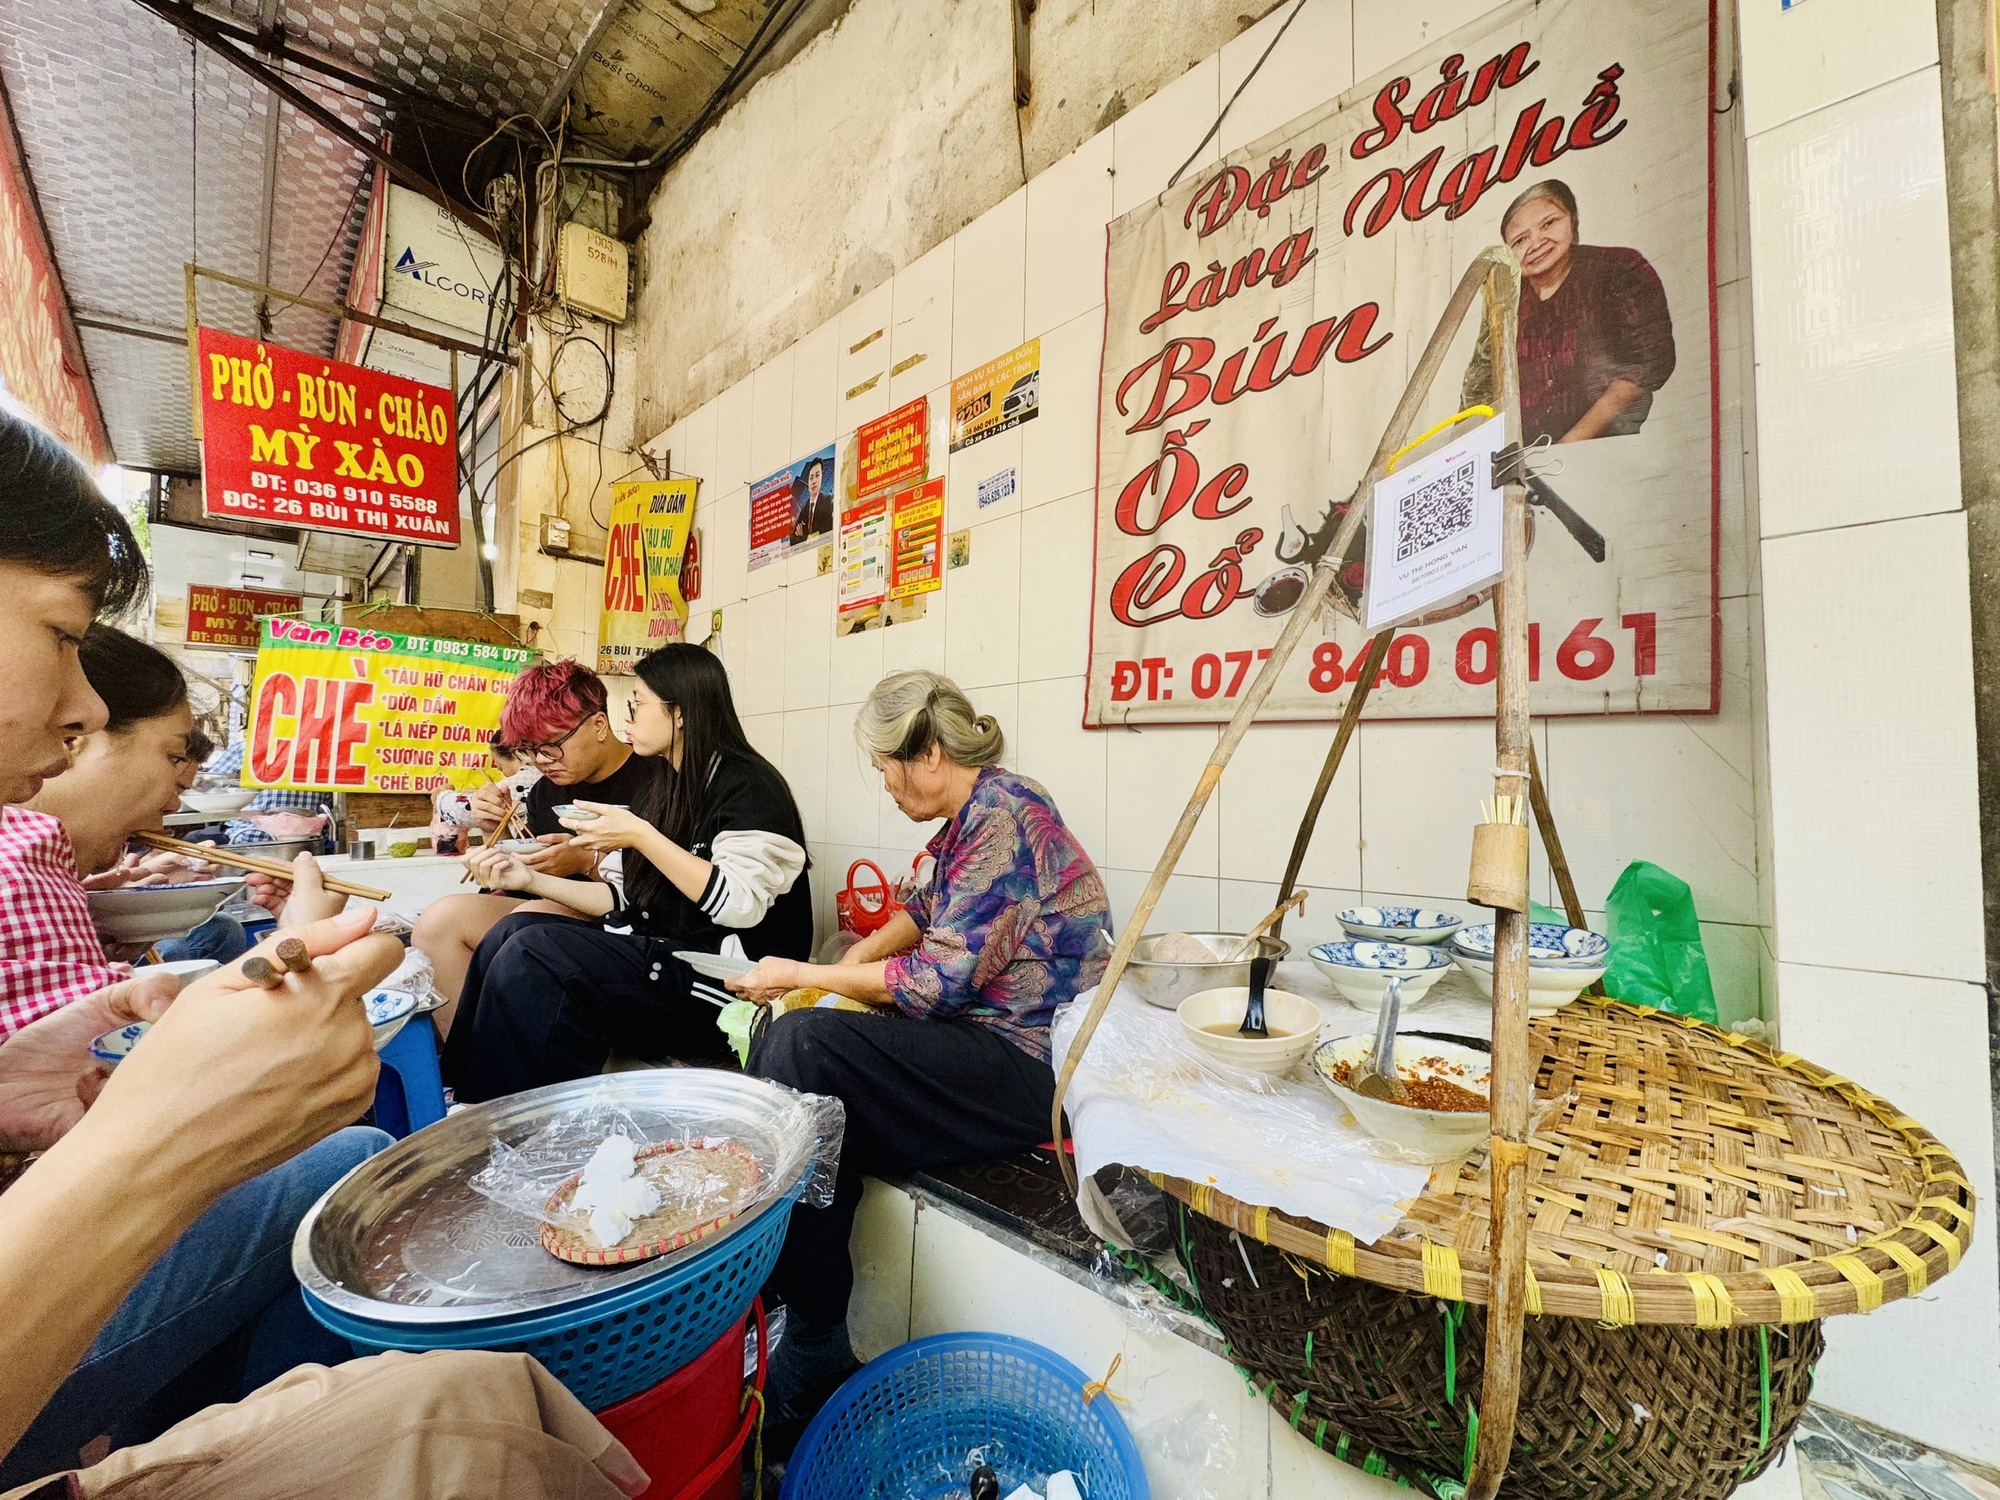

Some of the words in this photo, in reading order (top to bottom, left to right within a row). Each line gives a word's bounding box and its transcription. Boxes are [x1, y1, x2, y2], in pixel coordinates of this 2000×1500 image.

[592, 50, 623, 76] Best
[625, 71, 668, 102] Choice
[1183, 142, 1330, 240] Đặc
[1349, 40, 1540, 161] Sản
[1138, 225, 1320, 336] Làng
[1342, 61, 1629, 240] Nghề
[1115, 300, 1395, 436] Bún
[209, 343, 275, 411] PHỞ
[297, 365, 358, 428] BÚN
[378, 389, 449, 447] CHÁO
[249, 422, 321, 471] MỲ
[333, 437, 425, 488] XÀO
[1114, 417, 1254, 537] Ốc
[222, 489, 266, 511] ĐC:
[273, 497, 304, 516] 26
[309, 502, 349, 523] BÙI
[354, 506, 389, 530] THỊ
[394, 512, 451, 536] XUÂN
[251, 470, 288, 493] ĐT:
[294, 478, 338, 499] 036
[343, 484, 384, 506] 910
[388, 494, 438, 515] 5588
[1109, 526, 1263, 629] Cổ
[1424, 554, 1448, 568] HONG
[1450, 543, 1468, 556] VAN
[213, 633, 237, 644] 036
[269, 617, 332, 644] Vân
[335, 626, 394, 651] Béo
[407, 636, 430, 652] ĐT:
[433, 639, 469, 656] 0983
[472, 644, 499, 659] 584
[502, 648, 528, 663] 078
[600, 644, 612, 655] 26
[614, 643, 631, 655] BÙI
[423, 670, 443, 688] HŨ
[448, 674, 487, 692] CHÂN
[1110, 656, 1174, 702] ĐT:
[1308, 633, 1431, 694] 840
[252, 658, 375, 784] CHÈ
[422, 694, 457, 715] DẦM
[407, 719, 438, 739] NẾP
[442, 723, 471, 742] DỪA
[438, 751, 457, 767] SA
[461, 752, 488, 771] HẠT
